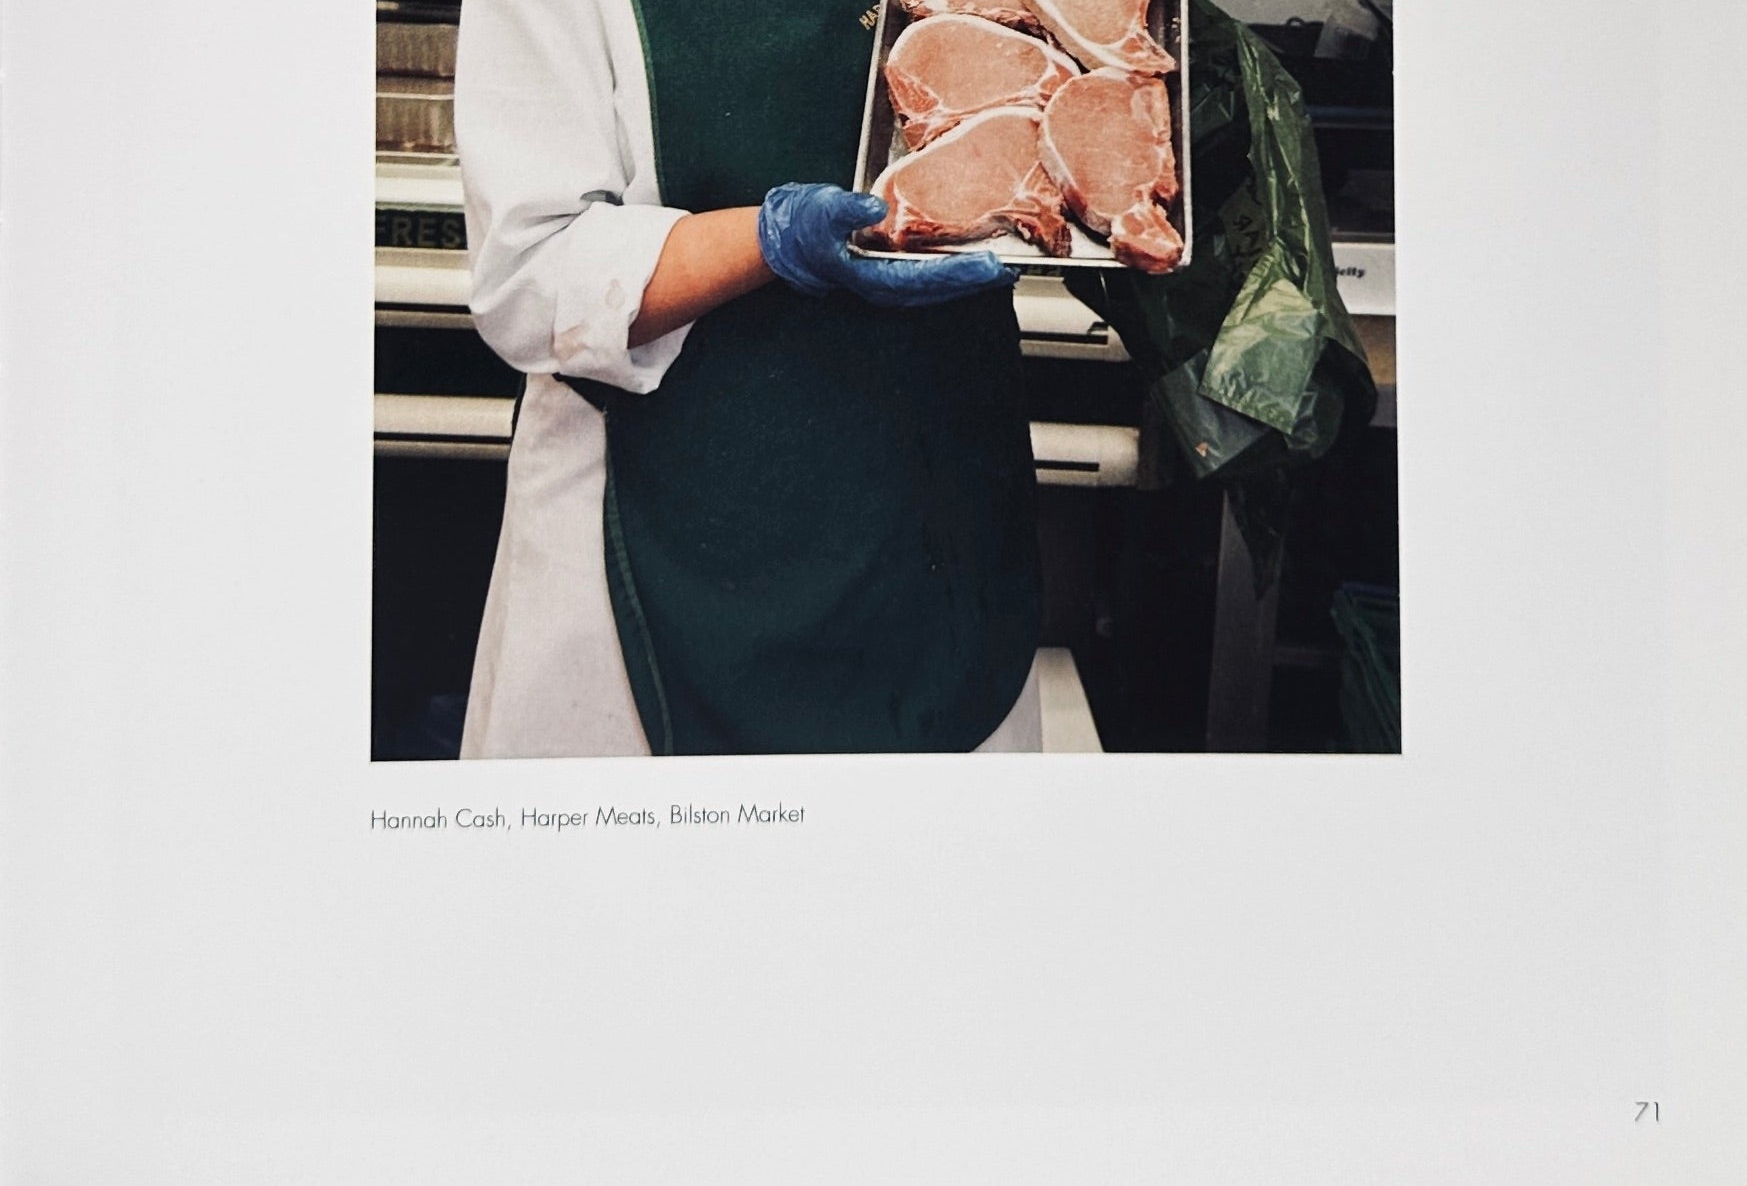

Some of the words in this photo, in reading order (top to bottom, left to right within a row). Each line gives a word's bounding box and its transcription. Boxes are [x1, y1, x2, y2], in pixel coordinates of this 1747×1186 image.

[371, 807, 448, 830] Hannah
[455, 807, 511, 830] Cash,
[521, 807, 588, 832] Harper
[595, 805, 661, 828] Meats,
[670, 803, 730, 825] Bilston
[737, 801, 805, 824] Market
[1634, 1101, 1659, 1122] 71
